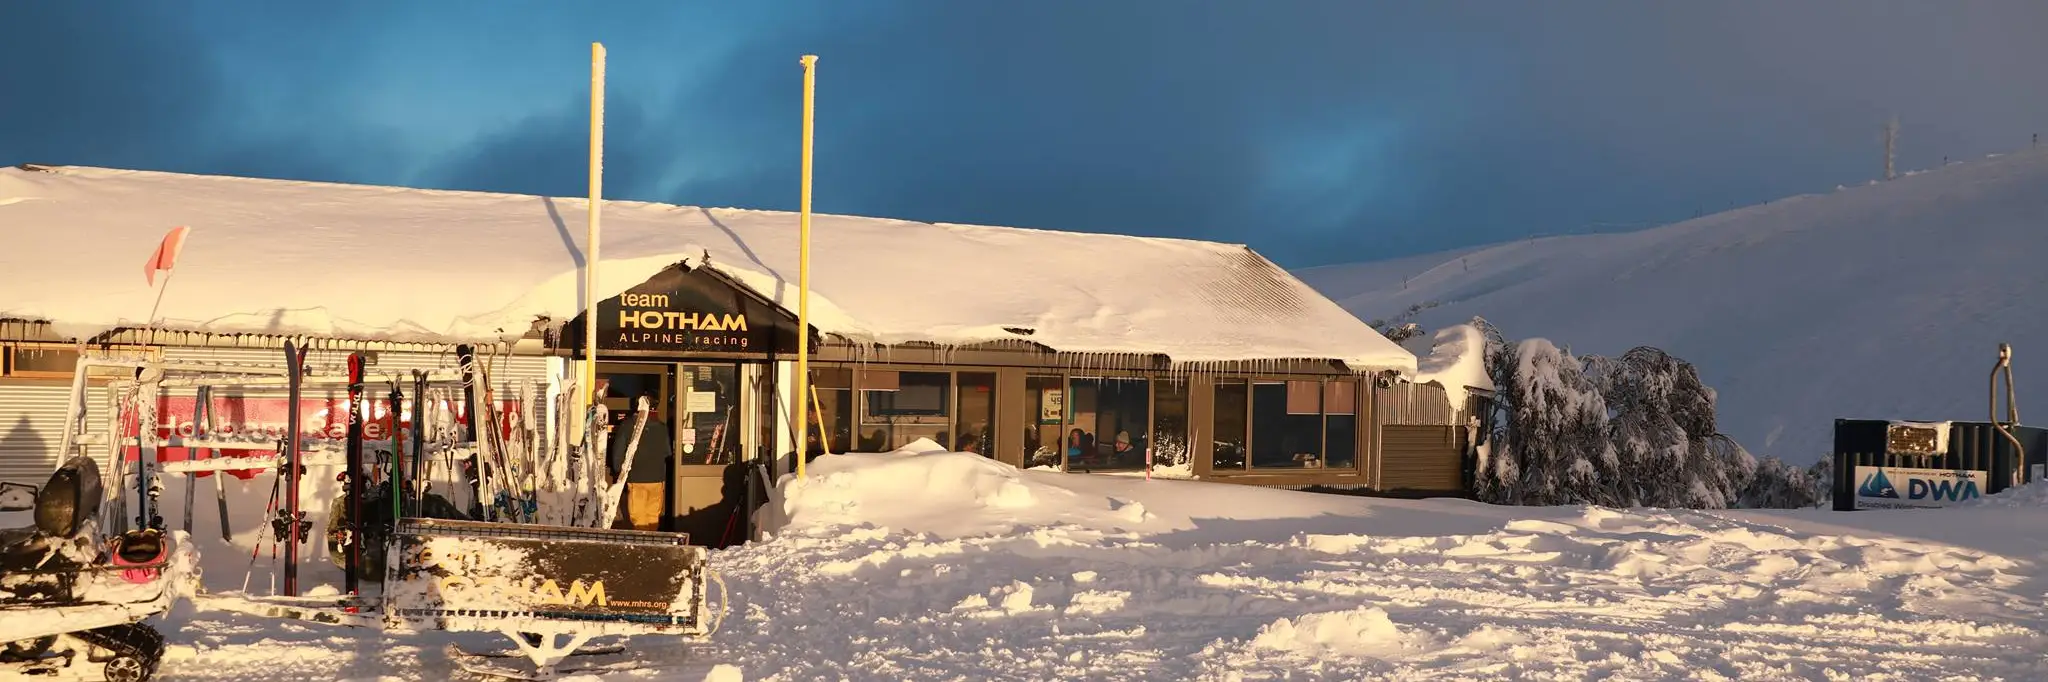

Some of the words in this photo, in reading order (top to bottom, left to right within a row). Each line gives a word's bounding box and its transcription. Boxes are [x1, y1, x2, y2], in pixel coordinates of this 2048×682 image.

[620, 291, 669, 308] team
[620, 310, 748, 331] HOTHAM
[619, 333, 683, 344] ALPINE
[695, 336, 748, 347] racing
[1908, 479, 1979, 502] DWA
[609, 600, 669, 610] www.mhrs.org
